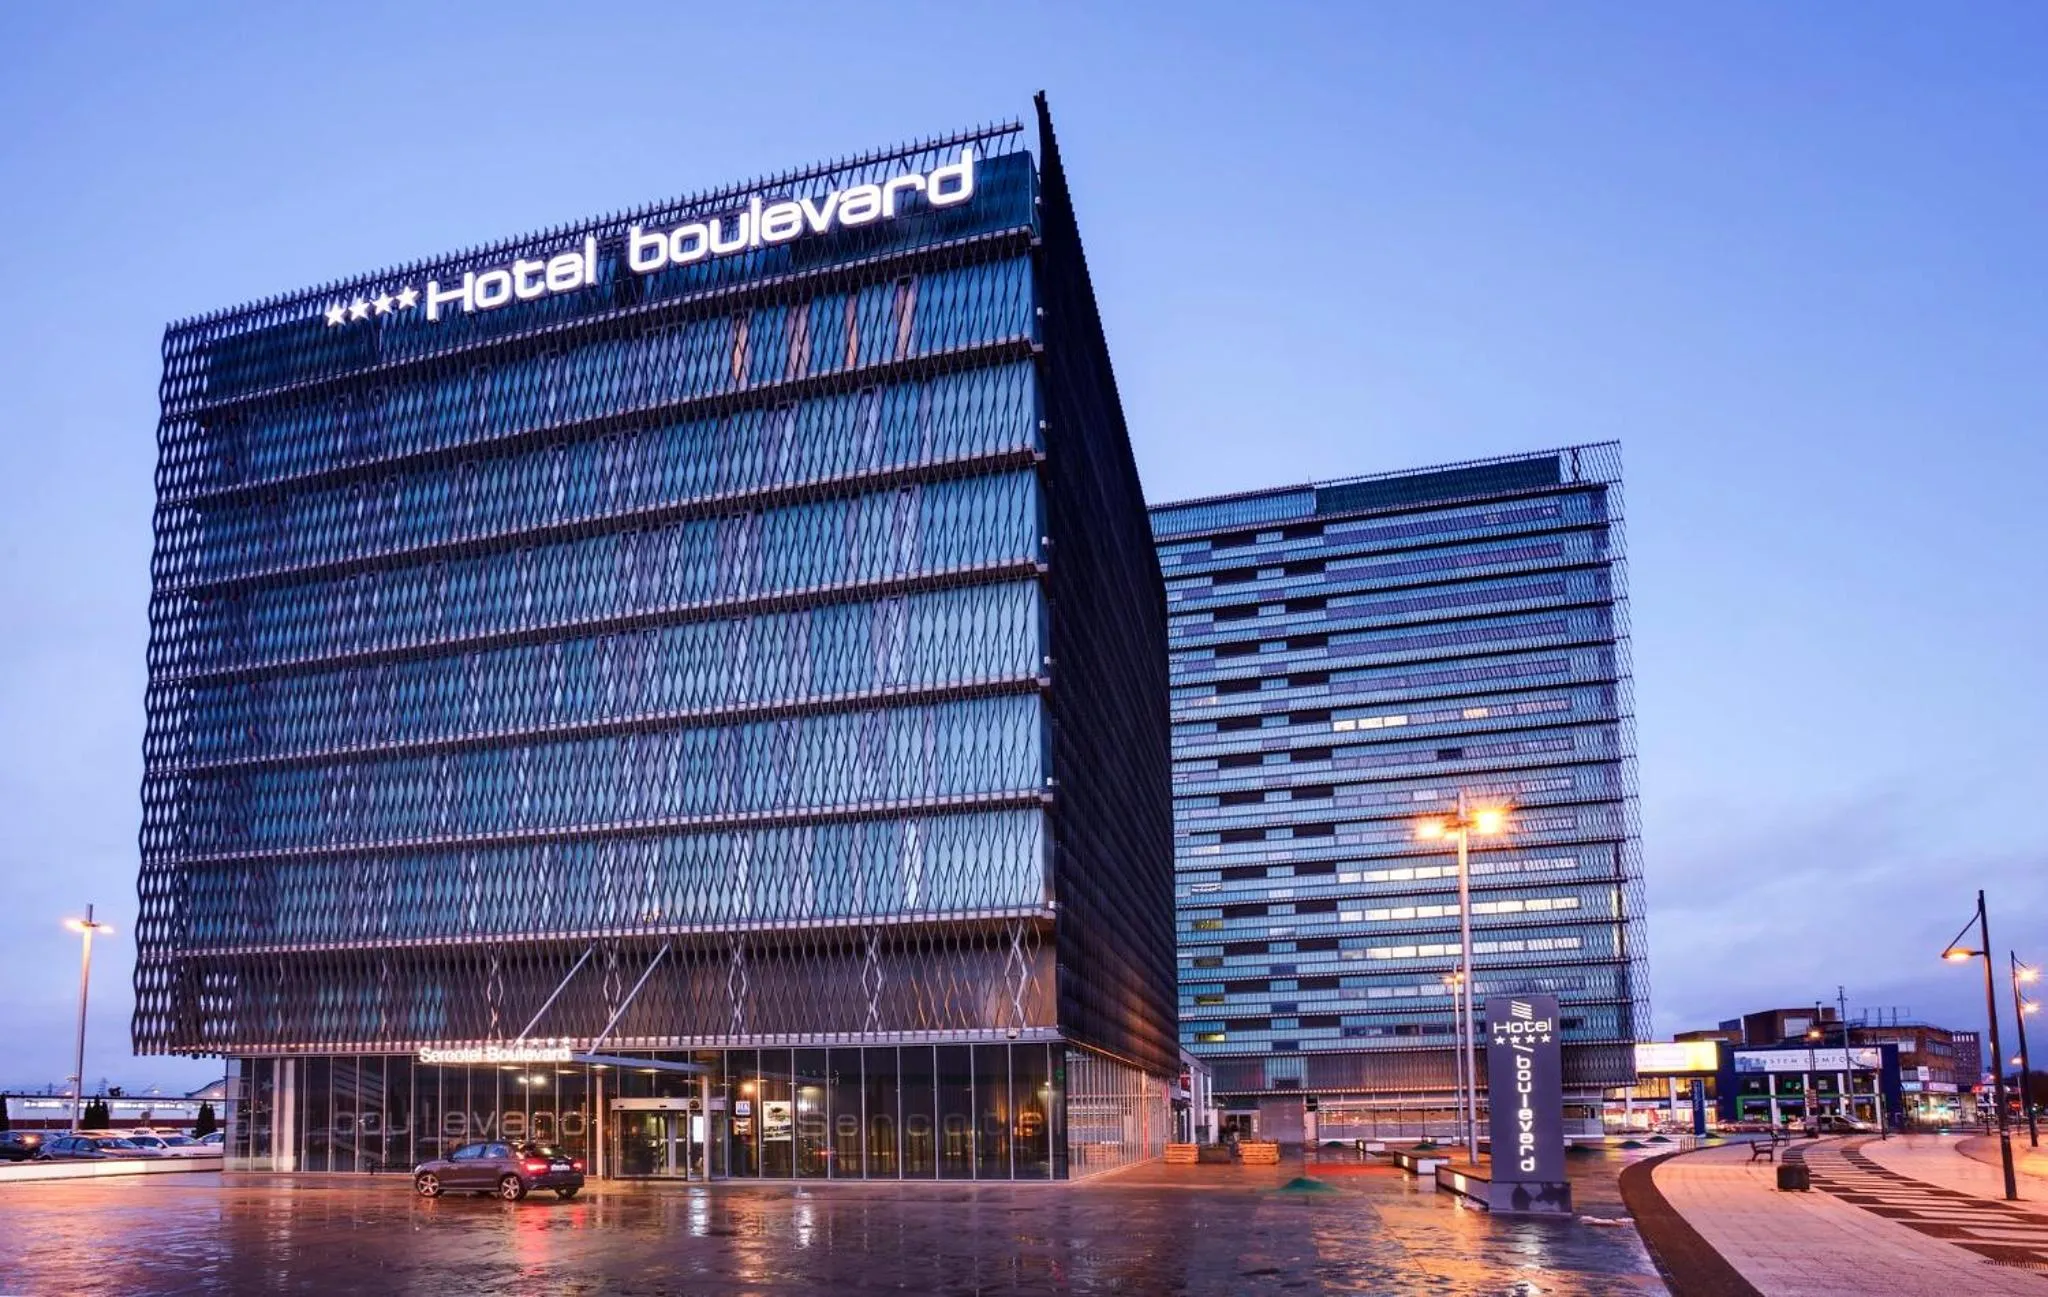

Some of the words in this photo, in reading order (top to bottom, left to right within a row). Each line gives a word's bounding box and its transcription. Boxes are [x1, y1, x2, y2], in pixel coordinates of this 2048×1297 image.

[426, 236, 598, 321] Hotel
[628, 148, 975, 273] boulevard
[486, 1046, 571, 1061] Boulevard
[1493, 1017, 1552, 1034] Hotel
[1516, 1055, 1536, 1172] boulevard
